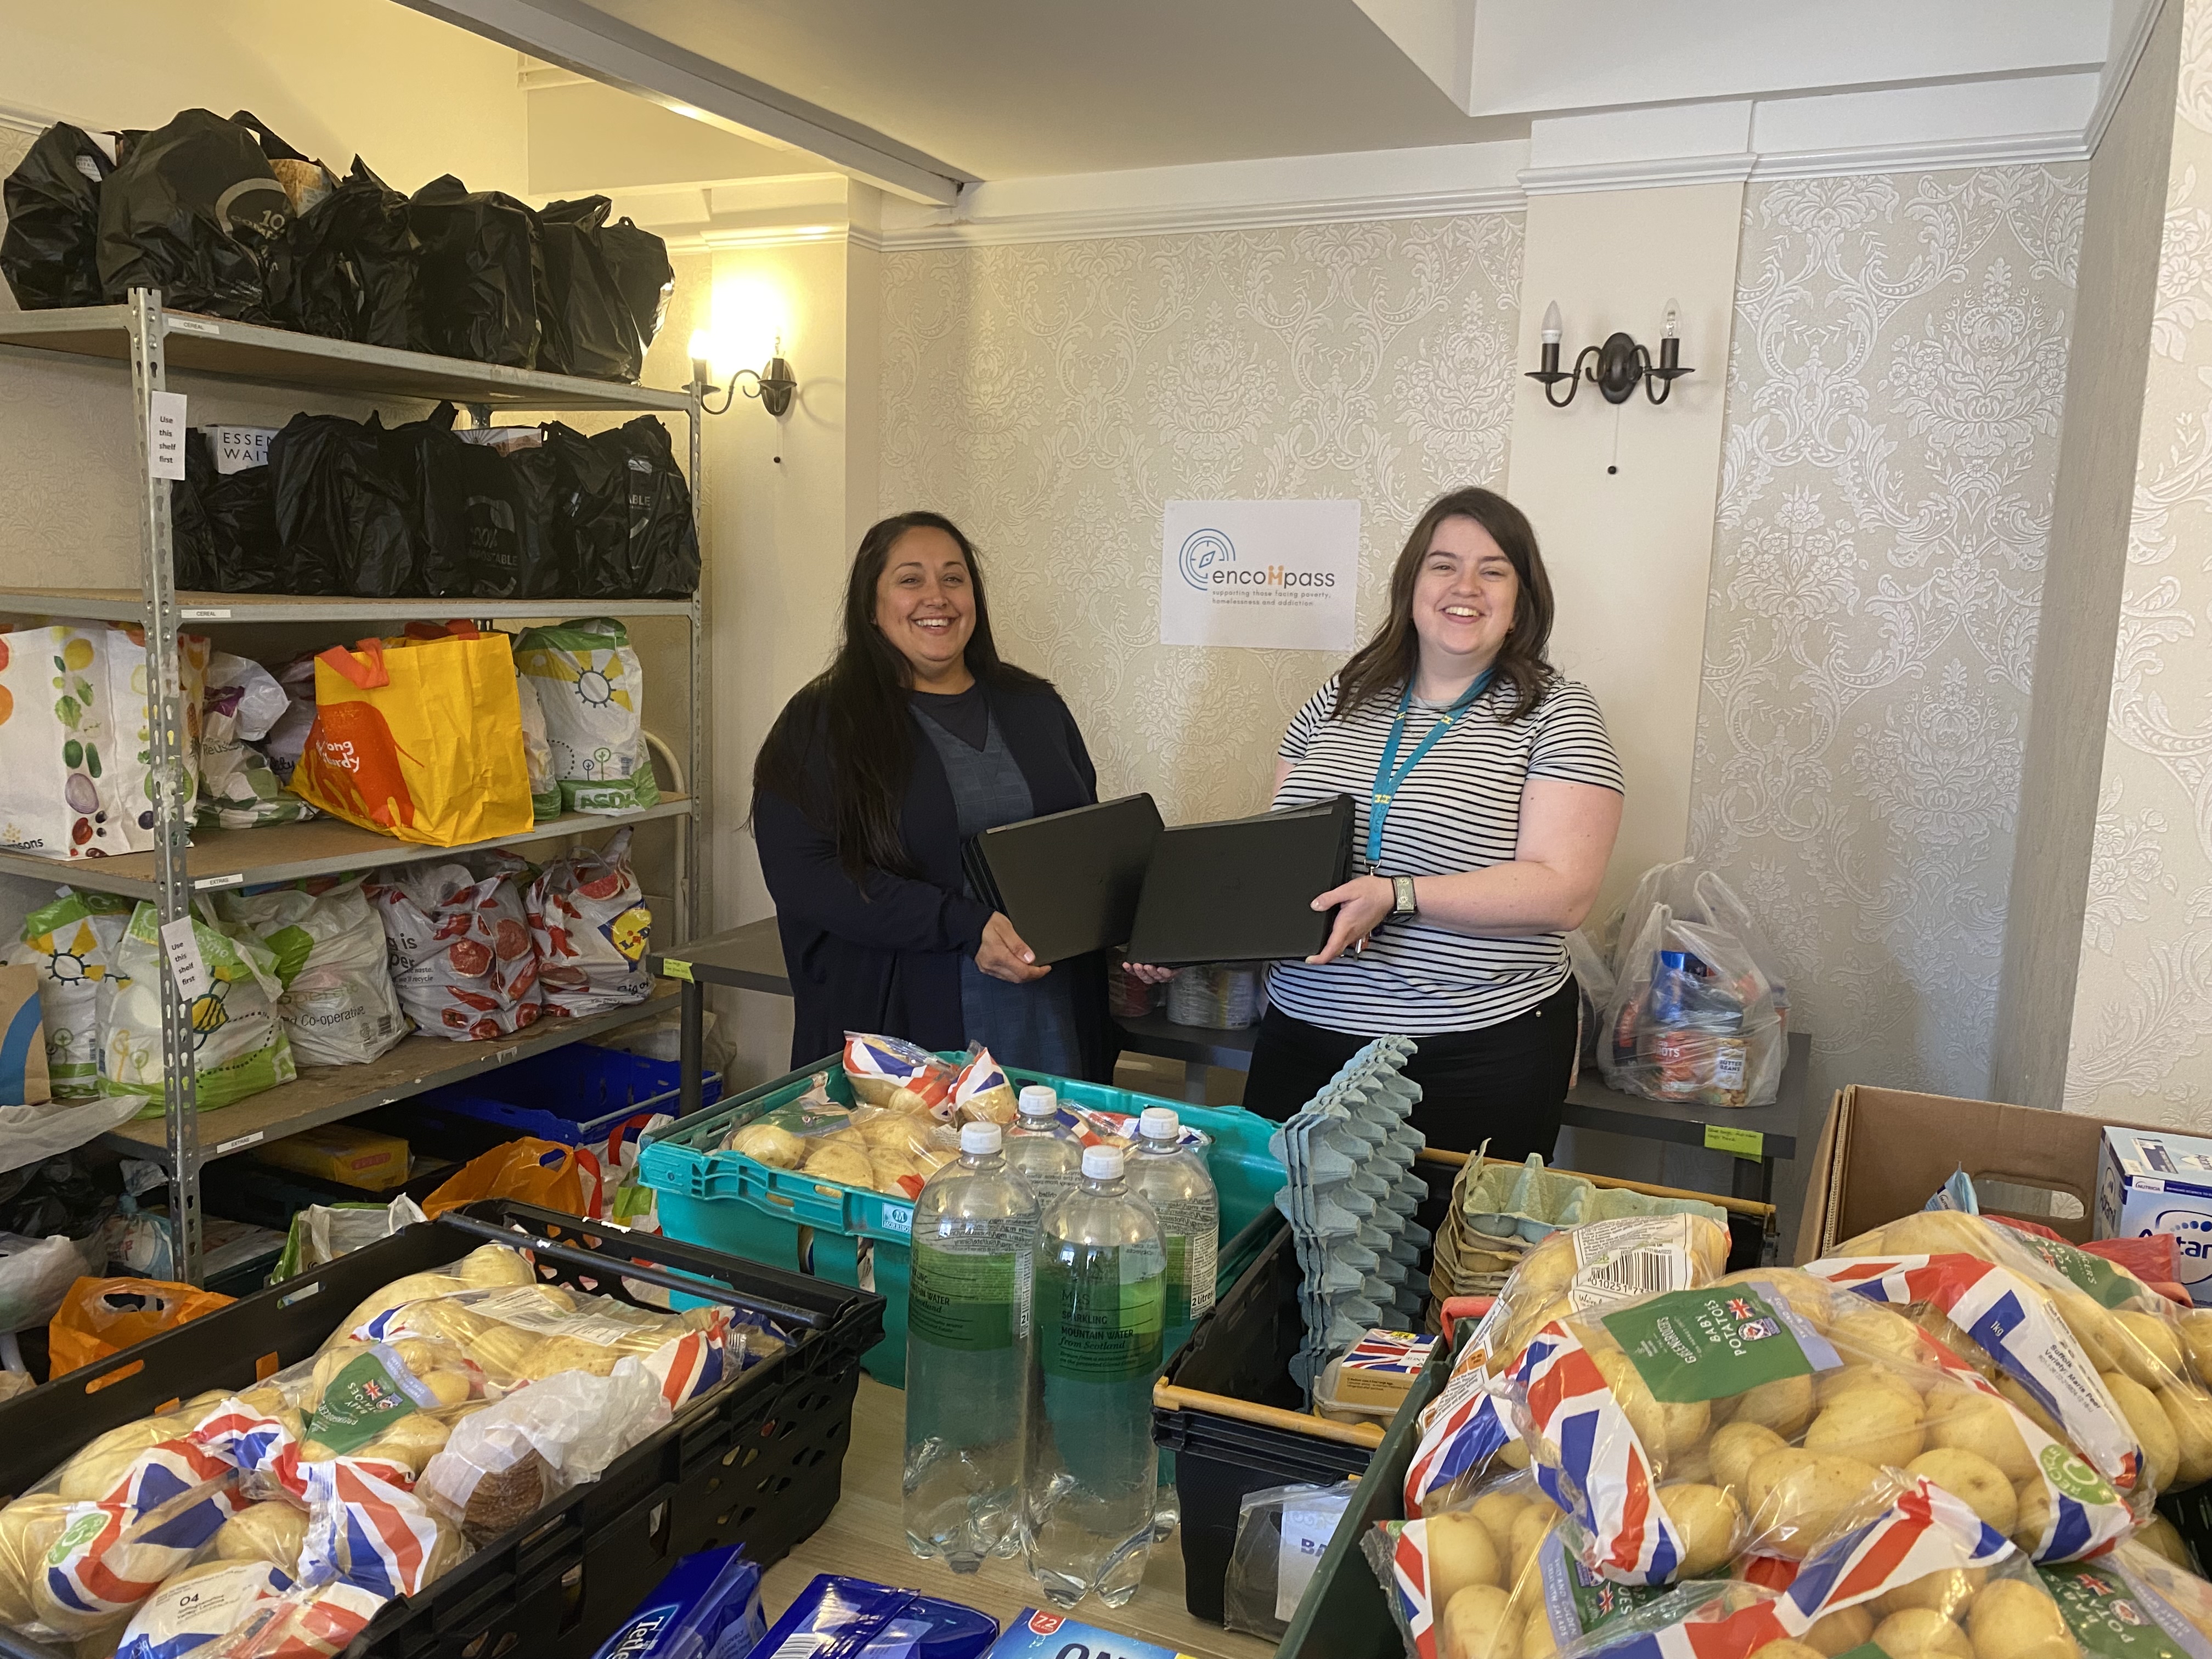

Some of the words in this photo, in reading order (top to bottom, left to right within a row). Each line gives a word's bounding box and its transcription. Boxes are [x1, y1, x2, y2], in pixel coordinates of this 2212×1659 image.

[223, 432, 274, 446] ESSEN
[224, 448, 268, 461] WAIT
[580, 792, 641, 809] ASDA
[210, 877, 229, 885] EXTRAS
[171, 941, 184, 950] Use
[400, 933, 417, 949] is
[174, 953, 187, 962] this
[178, 962, 194, 974] shelf
[182, 975, 196, 985] first
[301, 1006, 366, 1027] Co-operative
[231, 1137, 250, 1147] EXTRAS
[2137, 1183, 2161, 1192] NUTRICIA
[884, 1221, 911, 1233] MORRISO
[1591, 1278, 1627, 1293] 010251
[927, 1292, 950, 1306] WATER
[1062, 1290, 1090, 1305] M&S
[1192, 1297, 1197, 1306] 2
[1198, 1291, 1214, 1305] litres
[1062, 1310, 1108, 1324] SPARKLING
[1061, 1325, 1104, 1340] MOUNTAIN
[1107, 1329, 1134, 1340] WATER
[1695, 1314, 1721, 1342] BABY
[1703, 1300, 1747, 1357] POTATOES
[1990, 1320, 2004, 1337] 1kg
[1058, 1336, 1082, 1348] from
[1084, 1340, 1125, 1350] Scotland
[2050, 1344, 2073, 1369] Suffolk
[2067, 1373, 2085, 1393] Maris
[1558, 1578, 1567, 1598] AND
[1618, 1586, 1634, 1615] OES
[1037, 1615, 1058, 1628] 72
[1553, 1604, 1569, 1637] SALADS
[613, 1616, 664, 1659] Tetle
